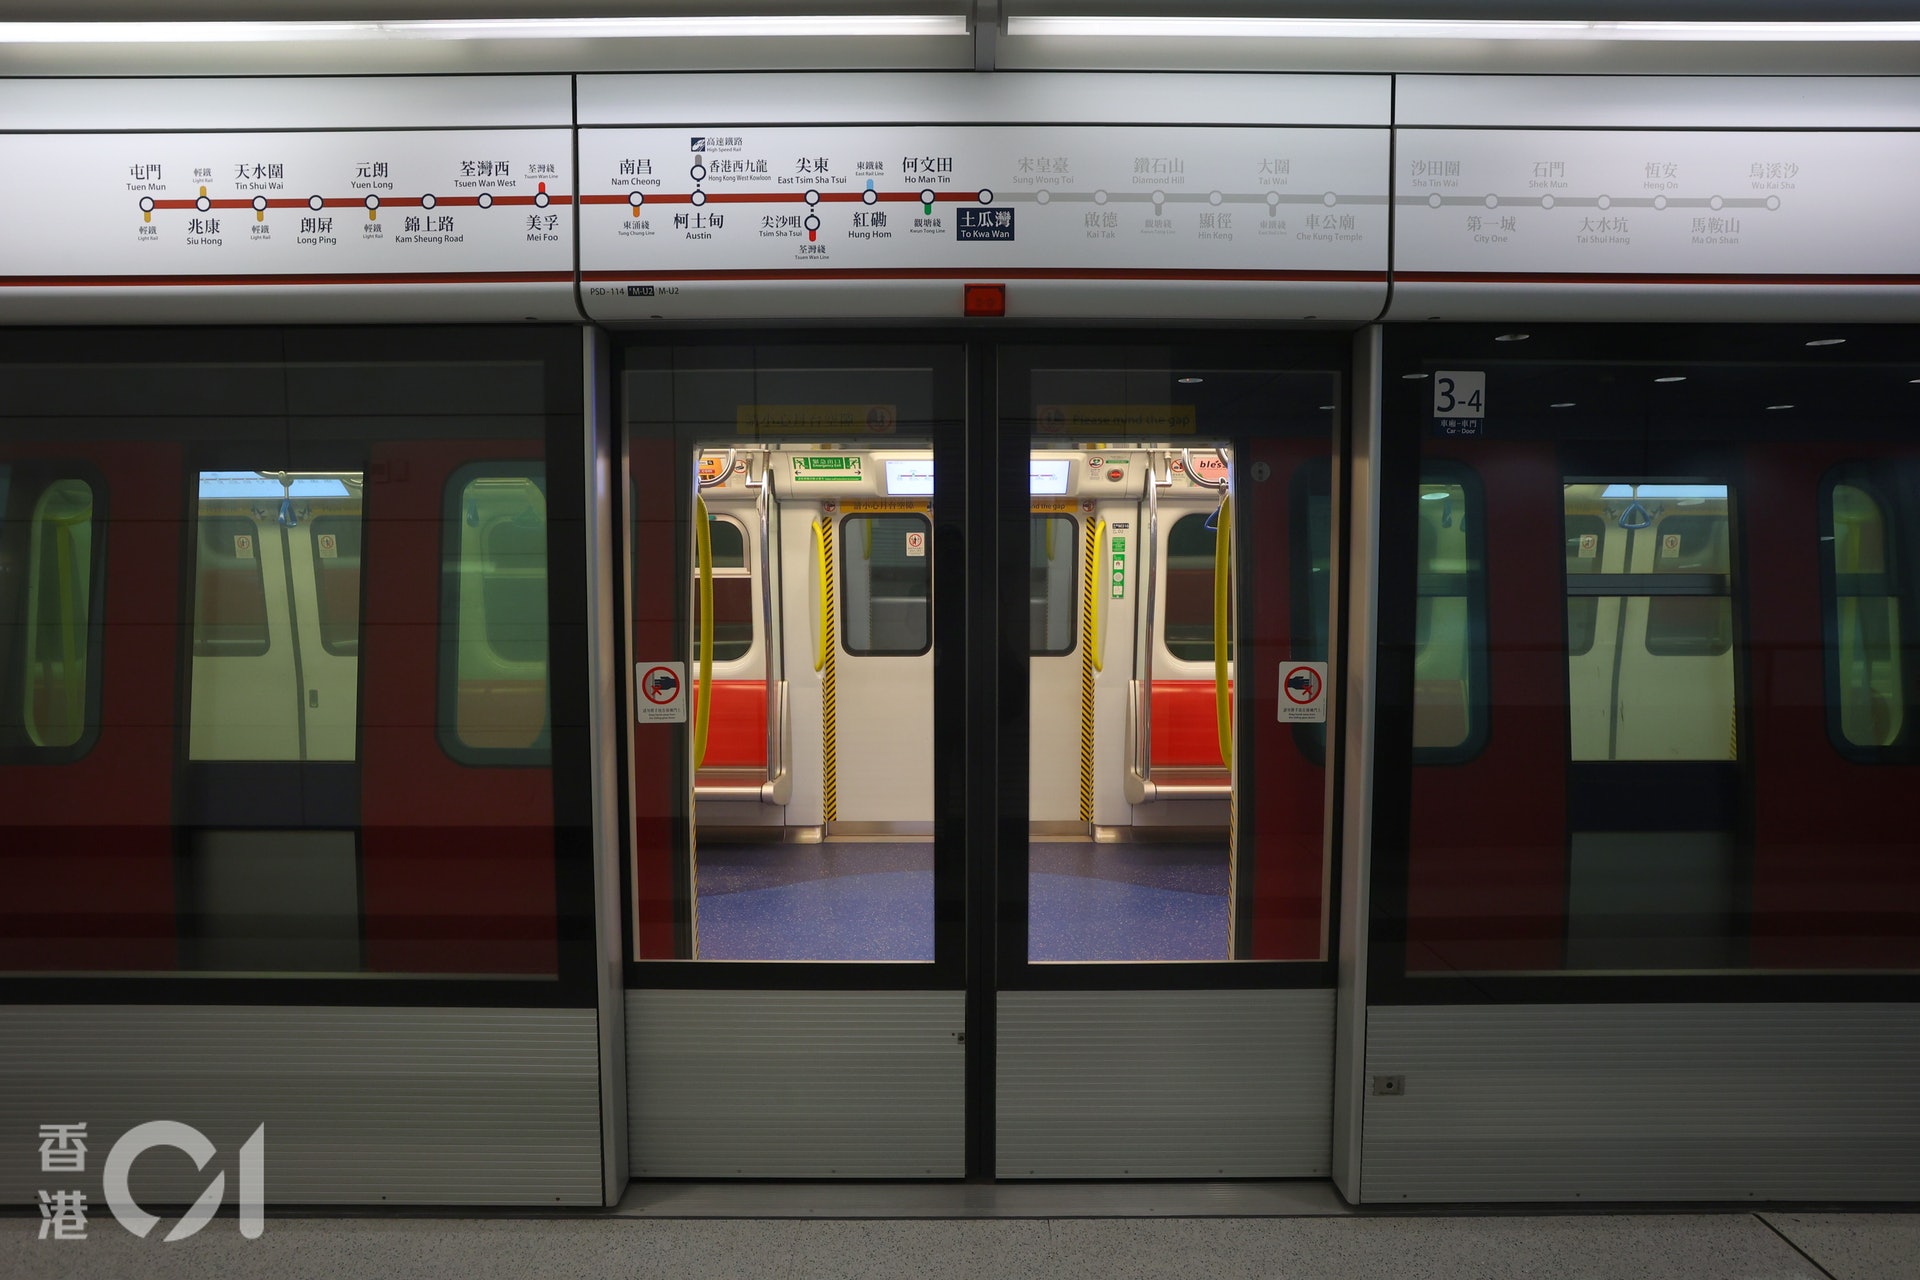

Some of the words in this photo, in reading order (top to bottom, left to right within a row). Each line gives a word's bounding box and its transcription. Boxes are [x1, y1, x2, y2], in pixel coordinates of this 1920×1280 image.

[707, 137, 743, 146] 高速鐵路
[129, 164, 161, 180] 屯門
[234, 164, 284, 179] 天水圍
[356, 162, 388, 178] 元朗
[460, 161, 510, 176] 荃灣西
[620, 159, 652, 175] 南昌
[709, 160, 768, 173] 香港西九龍
[796, 157, 828, 173] 尖東
[903, 157, 952, 173] 何文田
[1018, 157, 1069, 173] 宋皇臺
[1134, 157, 1183, 173] 鑽石山
[1258, 158, 1289, 174] 大圍
[1411, 160, 1460, 176] 沙田圍
[1532, 161, 1565, 178] 石門
[1750, 162, 1799, 179] 烏溪沙
[236, 182, 247, 190] Tin
[250, 182, 266, 190] Shui
[268, 182, 283, 190] Wai
[373, 181, 393, 190] Long
[631, 178, 660, 186] Cheong
[778, 176, 793, 184] East
[796, 176, 813, 184] Tsim
[815, 176, 829, 184] Sha
[831, 176, 846, 184] Tsui
[1012, 176, 1034, 184] Sung
[1036, 176, 1059, 184] Wong
[1644, 182, 1665, 190] Heng
[188, 218, 220, 234] 兆康
[300, 218, 332, 233] 朗屏
[405, 216, 454, 232] 錦上路
[526, 215, 559, 231] 美孚
[674, 212, 724, 229] 柯士甸
[762, 216, 802, 229] 尖沙咀
[853, 212, 887, 227] 紅磡
[960, 212, 1011, 228] 土瓜灣
[1199, 213, 1232, 229] 顯徑
[1306, 214, 1355, 230] 車公廟
[1467, 216, 1516, 232] 第一城
[1580, 217, 1628, 233] 大水坑
[1691, 218, 1740, 234] 馬鞍山
[201, 237, 222, 246] Hong
[297, 236, 317, 245] Long
[319, 236, 336, 245] Ping
[414, 235, 442, 244] Sheung
[848, 231, 870, 239] Hung
[1213, 232, 1233, 241] Keng
[1313, 233, 1333, 241] Kung
[1335, 233, 1362, 241] Temple
[1474, 235, 1490, 243] City
[1609, 237, 1630, 245] Hang
[1437, 378, 1482, 412] 3-4
[1168, 416, 1190, 426] gap
